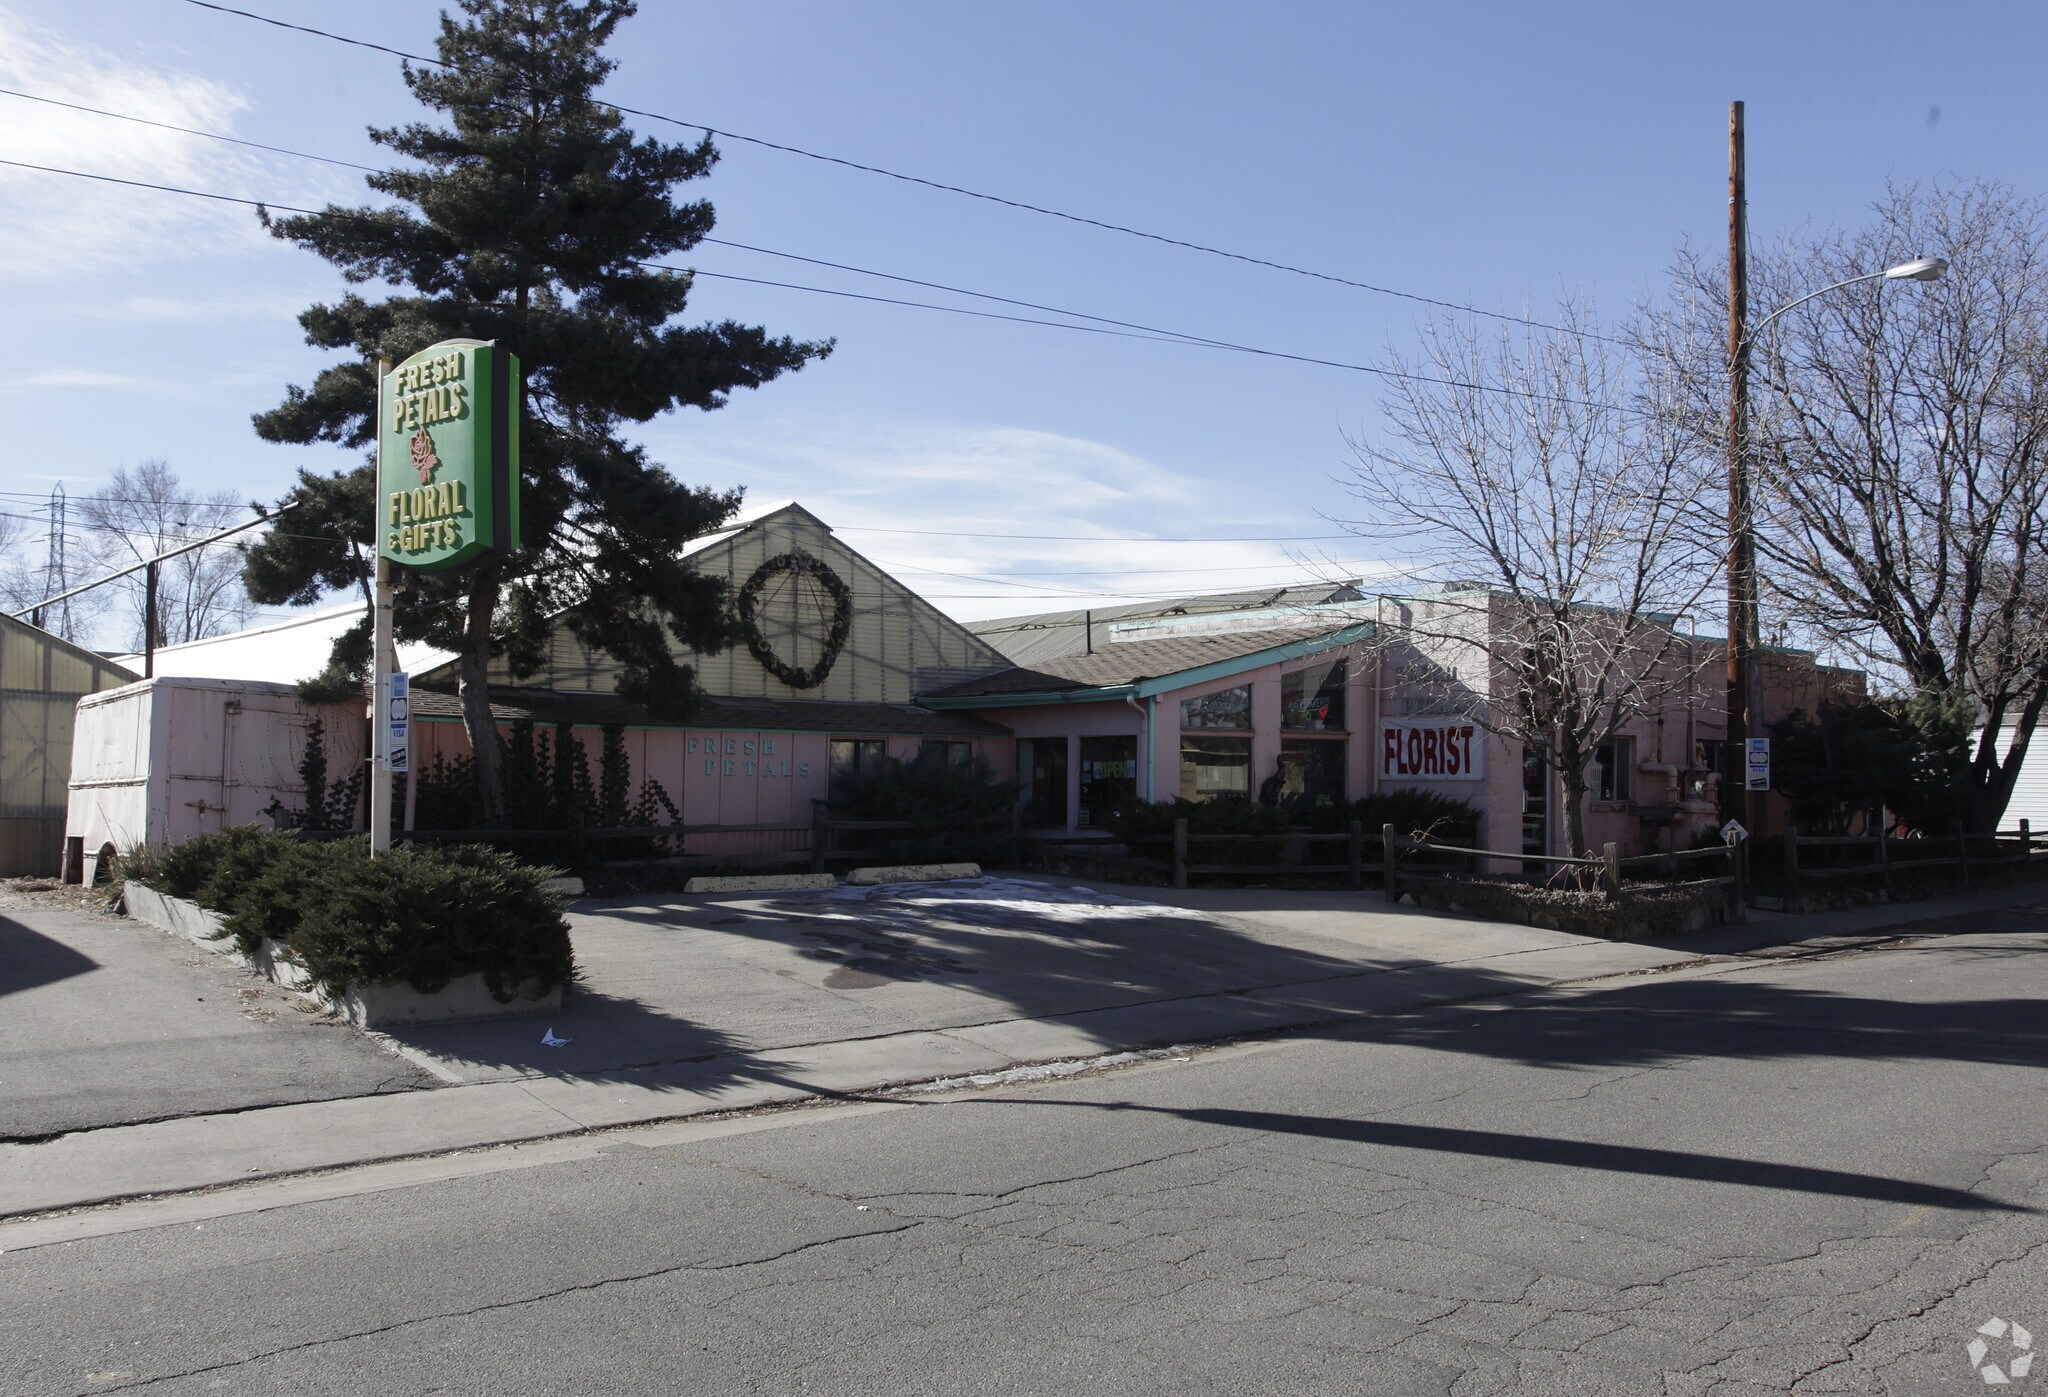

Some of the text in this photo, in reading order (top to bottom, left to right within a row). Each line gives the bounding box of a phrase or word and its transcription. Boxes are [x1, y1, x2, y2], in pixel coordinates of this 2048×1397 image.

[395, 351, 464, 395] FRESH
[393, 383, 465, 432] PETALS
[389, 480, 465, 525] FLORAL
[401, 518, 458, 551] GIFTS
[392, 729, 405, 738] VISA
[687, 737, 775, 755] FRESH
[1384, 726, 1474, 775] FLORIST
[705, 760, 810, 777] PETALS
[1101, 761, 1127, 778] OPEN
